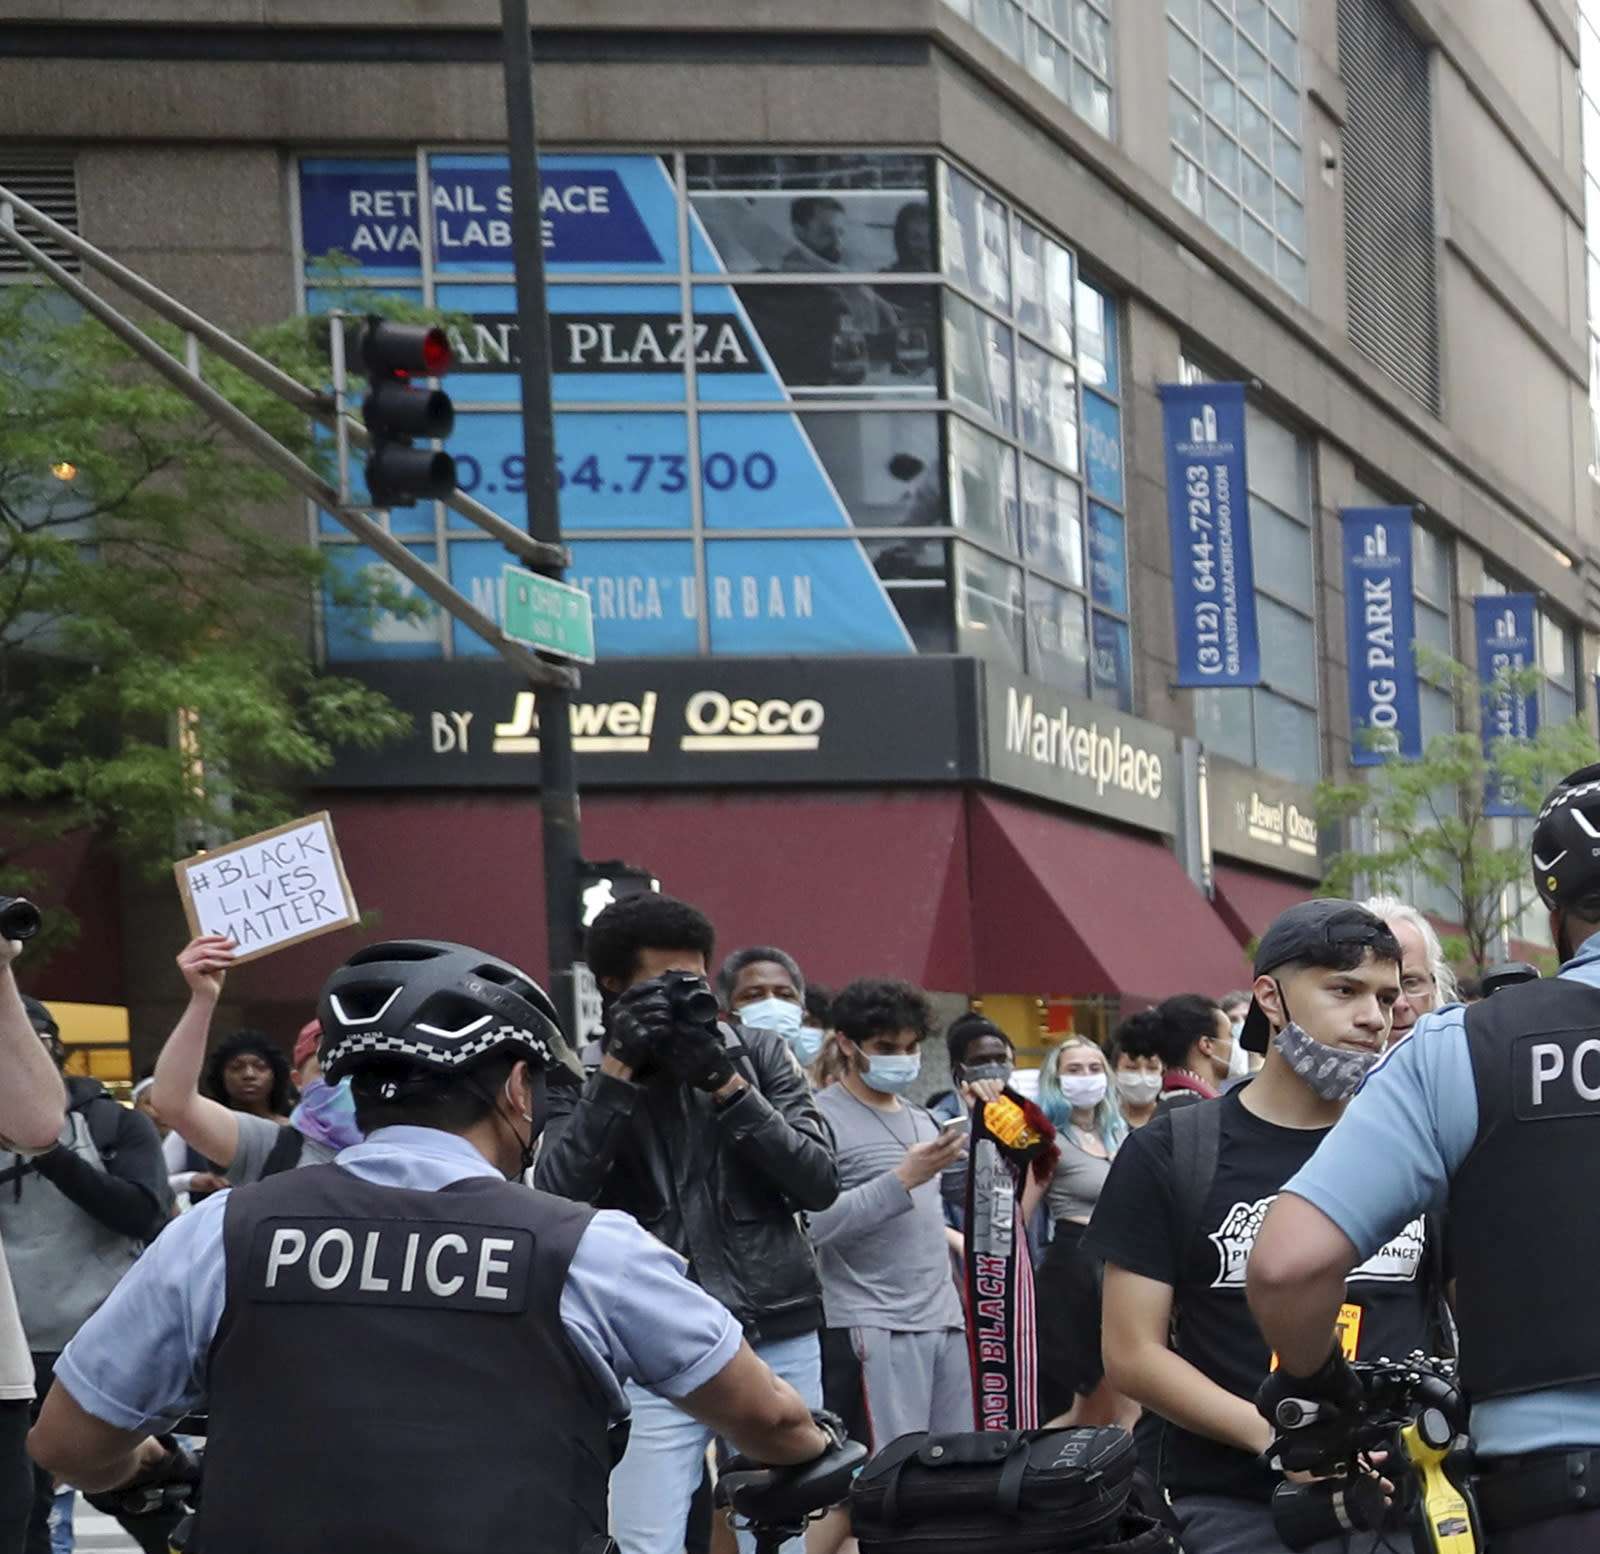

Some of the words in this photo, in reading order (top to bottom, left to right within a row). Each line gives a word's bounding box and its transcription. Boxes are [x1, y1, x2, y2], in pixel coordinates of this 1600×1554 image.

[349, 186, 487, 217] RETAIL
[496, 185, 610, 214] SACE
[351, 219, 556, 252] AVALABE
[566, 322, 749, 365] PLAZA
[1186, 464, 1216, 593] 644-7263
[681, 575, 813, 621] URBAN
[1363, 576, 1395, 670] PARK
[1193, 600, 1224, 675] (312)
[430, 711, 474, 754] BY
[494, 690, 658, 738] Jwel
[685, 690, 825, 735] Osco
[1005, 686, 1163, 800] Marketplace
[1249, 791, 1285, 834] Jewel
[1286, 804, 1318, 844] Osco
[210, 888, 338, 946] MATTER
[218, 865, 318, 916] LIVES
[265, 1227, 515, 1301] POLICE
[975, 1252, 1007, 1364] BLACK
